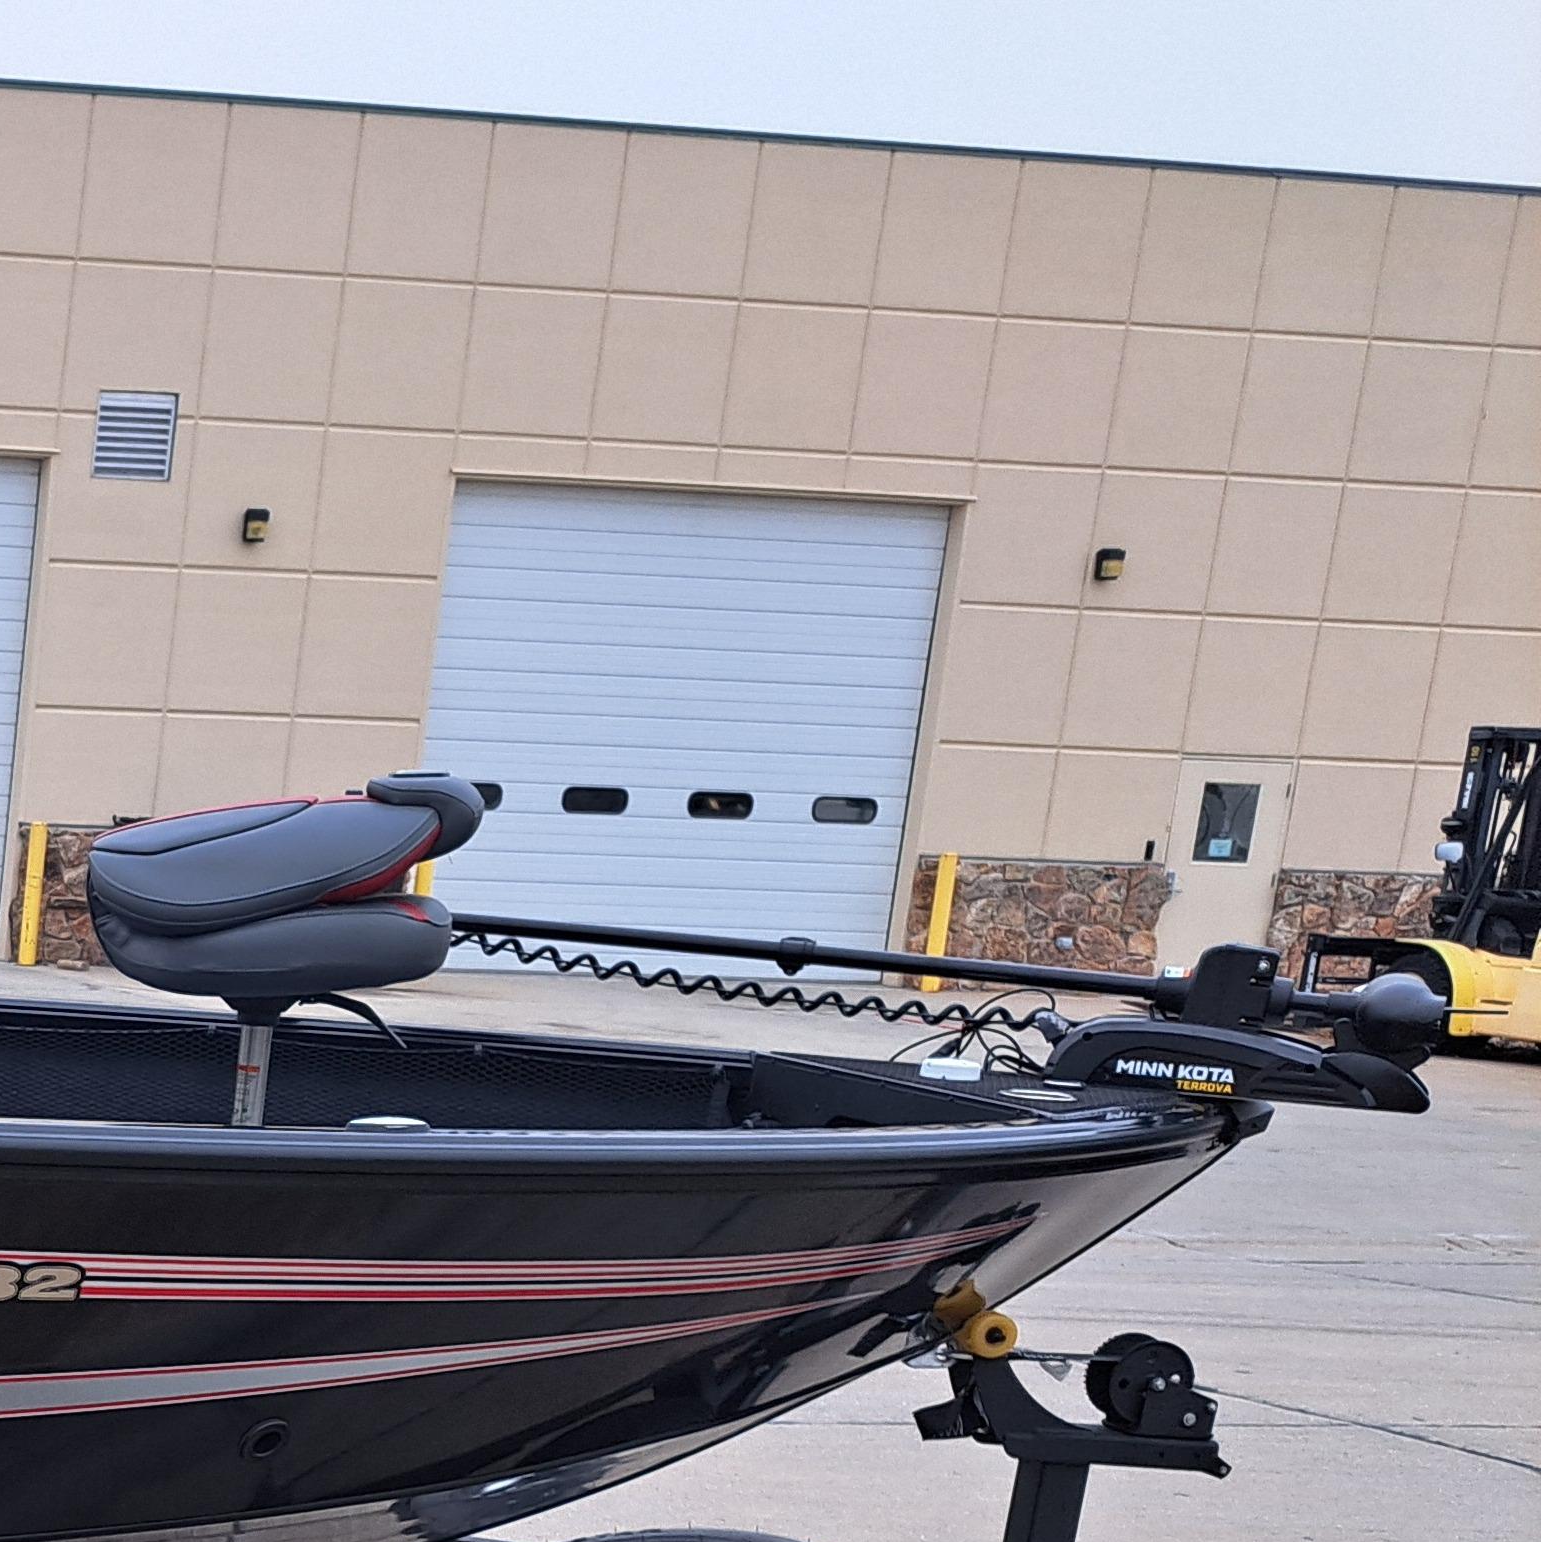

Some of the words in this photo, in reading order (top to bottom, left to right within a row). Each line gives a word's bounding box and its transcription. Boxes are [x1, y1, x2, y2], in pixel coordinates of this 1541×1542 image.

[1115, 1059, 1175, 1078] MINN
[1177, 1064, 1235, 1084] KOTA
[1176, 1080, 1233, 1094] TERROVA
